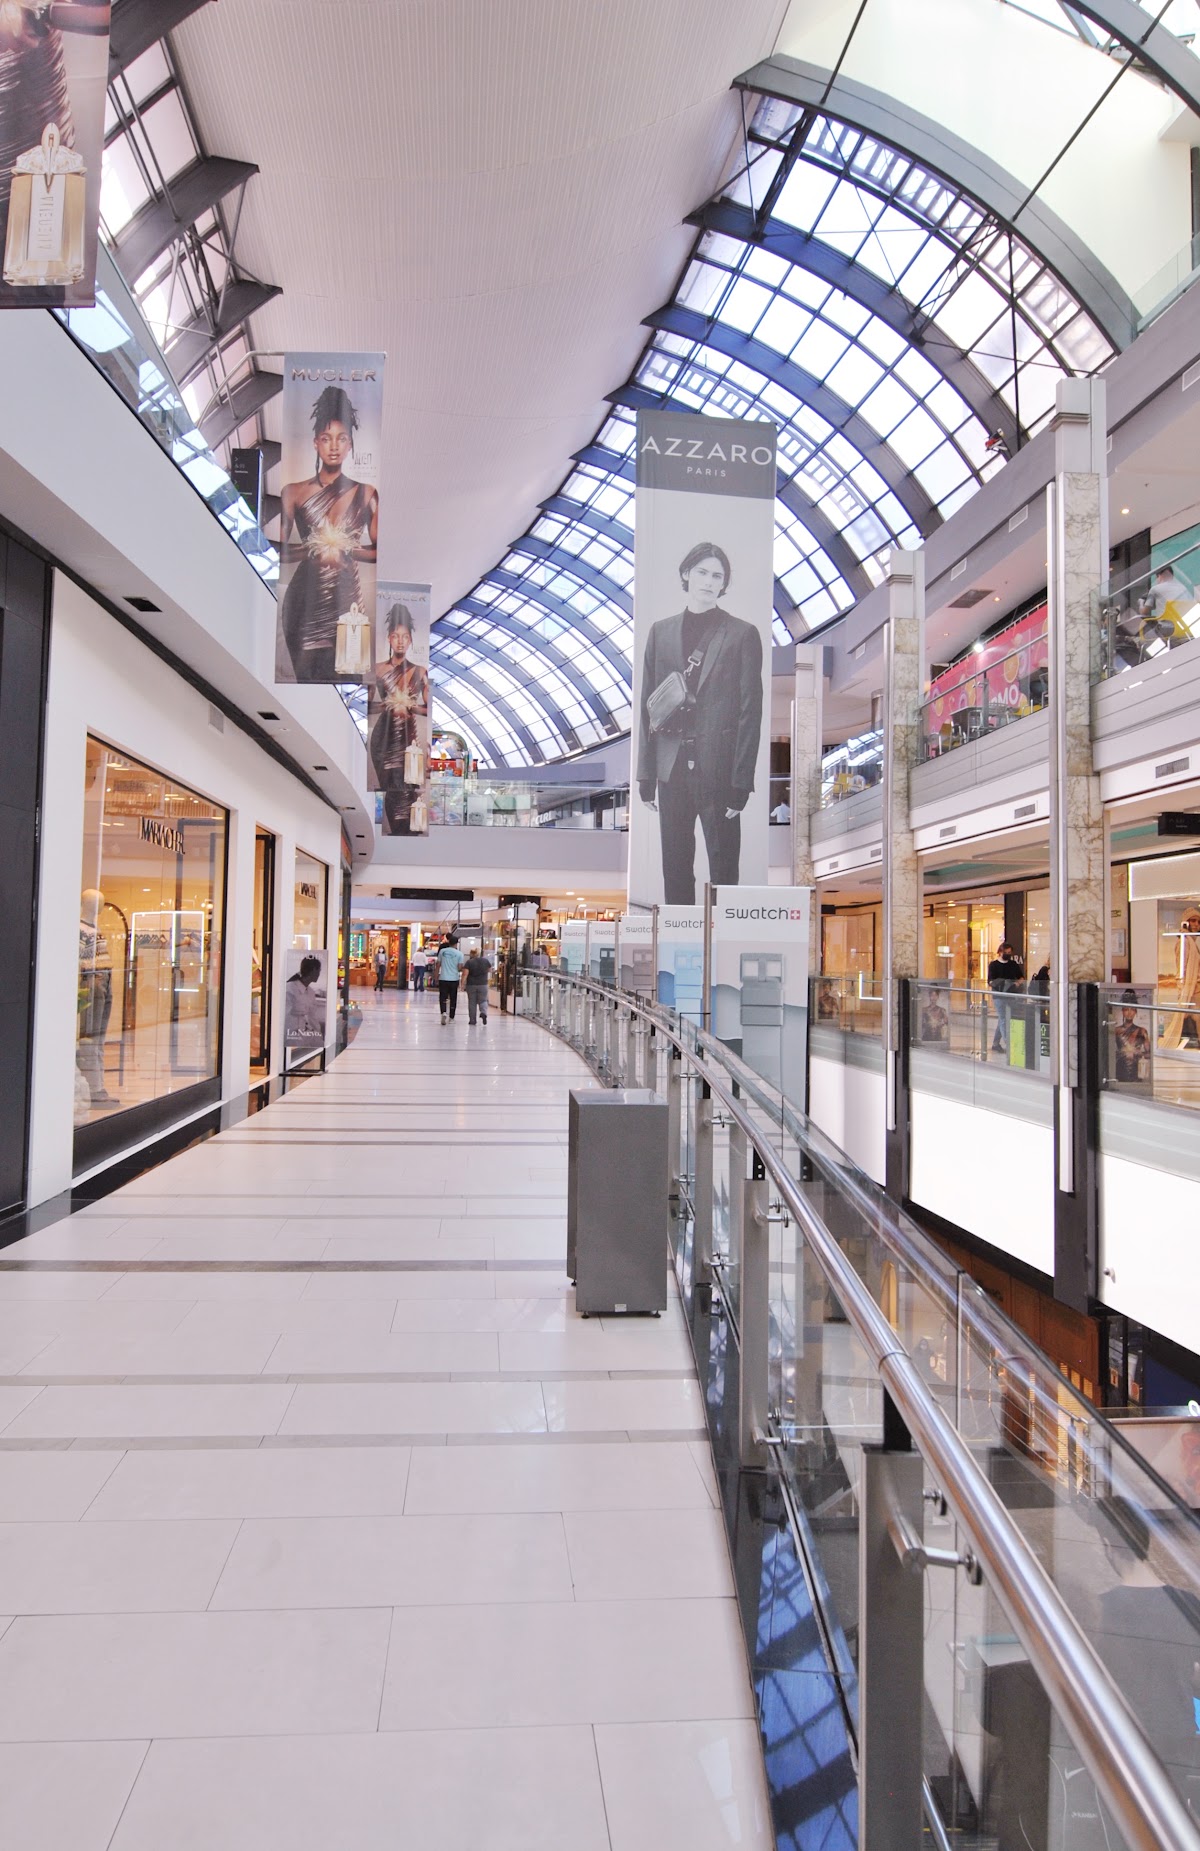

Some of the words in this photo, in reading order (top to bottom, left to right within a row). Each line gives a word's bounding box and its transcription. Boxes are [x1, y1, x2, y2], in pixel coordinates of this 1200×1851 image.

[292, 369, 376, 382] MUGLER
[640, 435, 773, 466] AZZARO
[686, 466, 727, 477] PARIS
[725, 907, 789, 920] swatch
[287, 1028, 297, 1036] Lo
